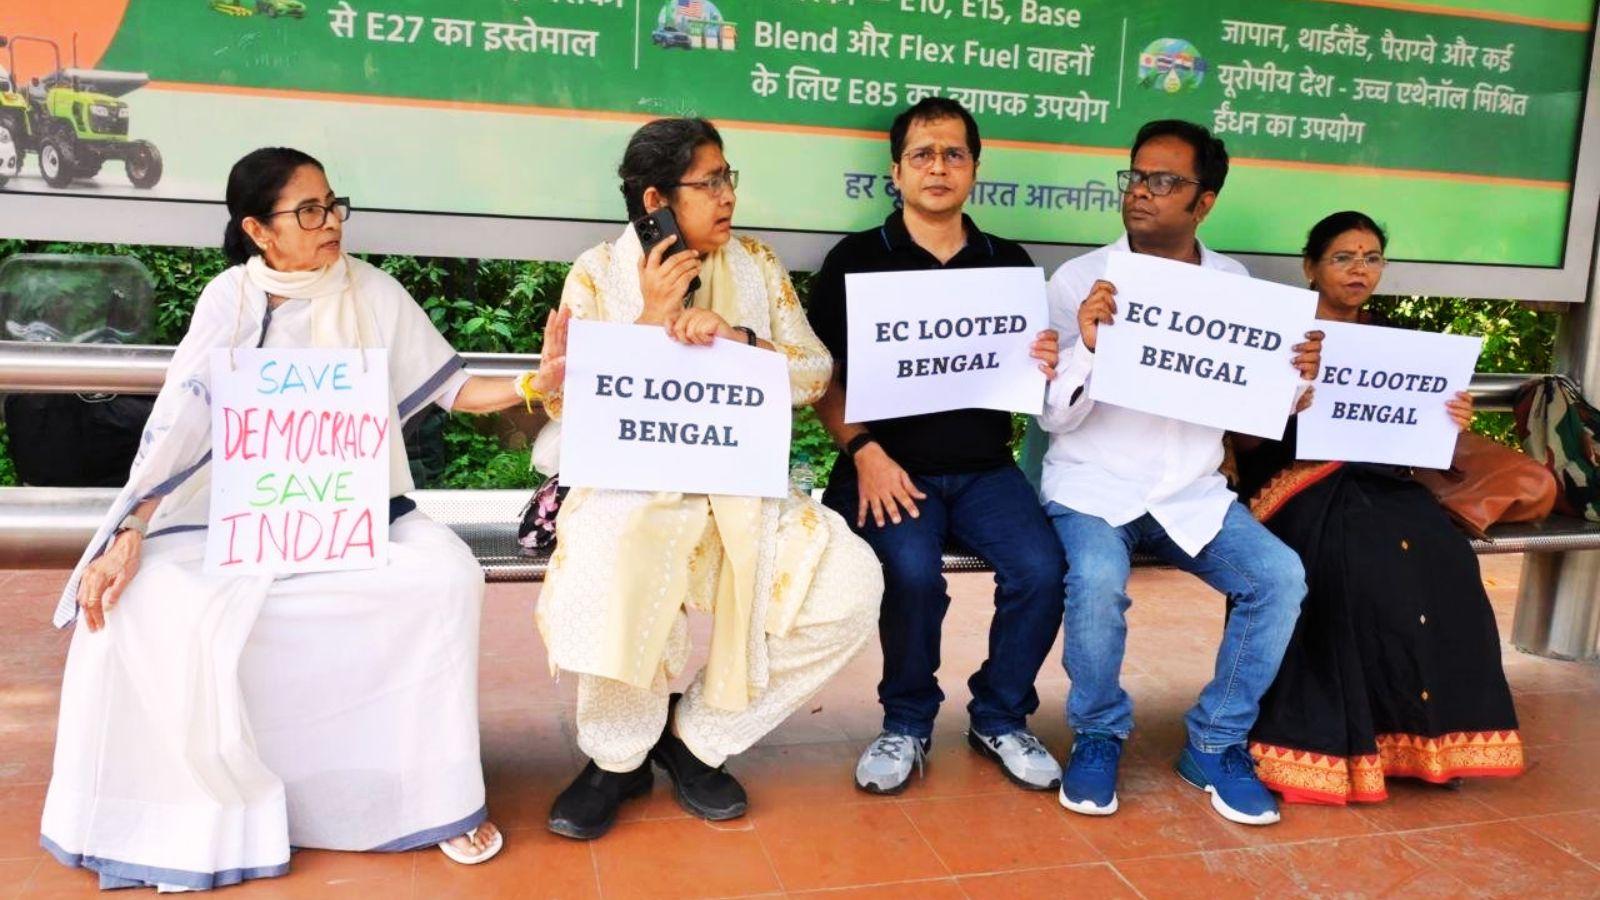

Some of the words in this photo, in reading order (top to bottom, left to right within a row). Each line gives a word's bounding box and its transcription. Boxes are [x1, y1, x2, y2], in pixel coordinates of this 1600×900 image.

[328, 1, 357, 39] से
[366, 12, 424, 43] E27
[431, 18, 476, 48] का
[481, 16, 600, 58] इस्तेमाल
[962, 0, 1012, 25] E15,
[1021, 0, 1081, 28] Base
[754, 21, 838, 54] Blend
[847, 20, 893, 58] और
[900, 34, 956, 64] Flex
[964, 40, 1020, 70] Fuel
[1027, 43, 1096, 77] वाहनों
[1221, 19, 1290, 53] जापान,
[1381, 28, 1438, 64] पैराग्वे
[1441, 35, 1479, 68] और
[1482, 43, 1515, 73] कई
[750, 63, 780, 97] के
[785, 65, 841, 101] लिए
[848, 79, 898, 107] E85
[1034, 90, 1110, 124] उपयोग
[1217, 59, 1295, 98] यूरोपीय
[1299, 65, 1334, 98] देश
[1353, 78, 1393, 103] उच्च
[1395, 77, 1469, 110] एथेनॉल
[1473, 82, 1529, 116] मिश्रित
[1264, 114, 1297, 138] का
[1300, 112, 1366, 144] उपयोग
[844, 172, 876, 199] हर
[875, 320, 910, 343] EC
[918, 314, 1028, 340] LOOTED
[1125, 301, 1162, 328] EC
[1168, 310, 1283, 352] LOOTED
[256, 359, 353, 395] SAVE
[897, 351, 1000, 379] BENGAL
[1140, 344, 1249, 387] BENGAL
[1321, 365, 1353, 386] EC
[1357, 368, 1449, 394] LOOTED
[595, 373, 634, 399] EC
[643, 377, 765, 408] LOOTED
[1331, 401, 1418, 426] BENGAL
[222, 406, 389, 465] DEMOCRACY
[618, 418, 739, 448] BENGAL
[248, 470, 356, 508] SAVE
[219, 507, 376, 567] INDIA
